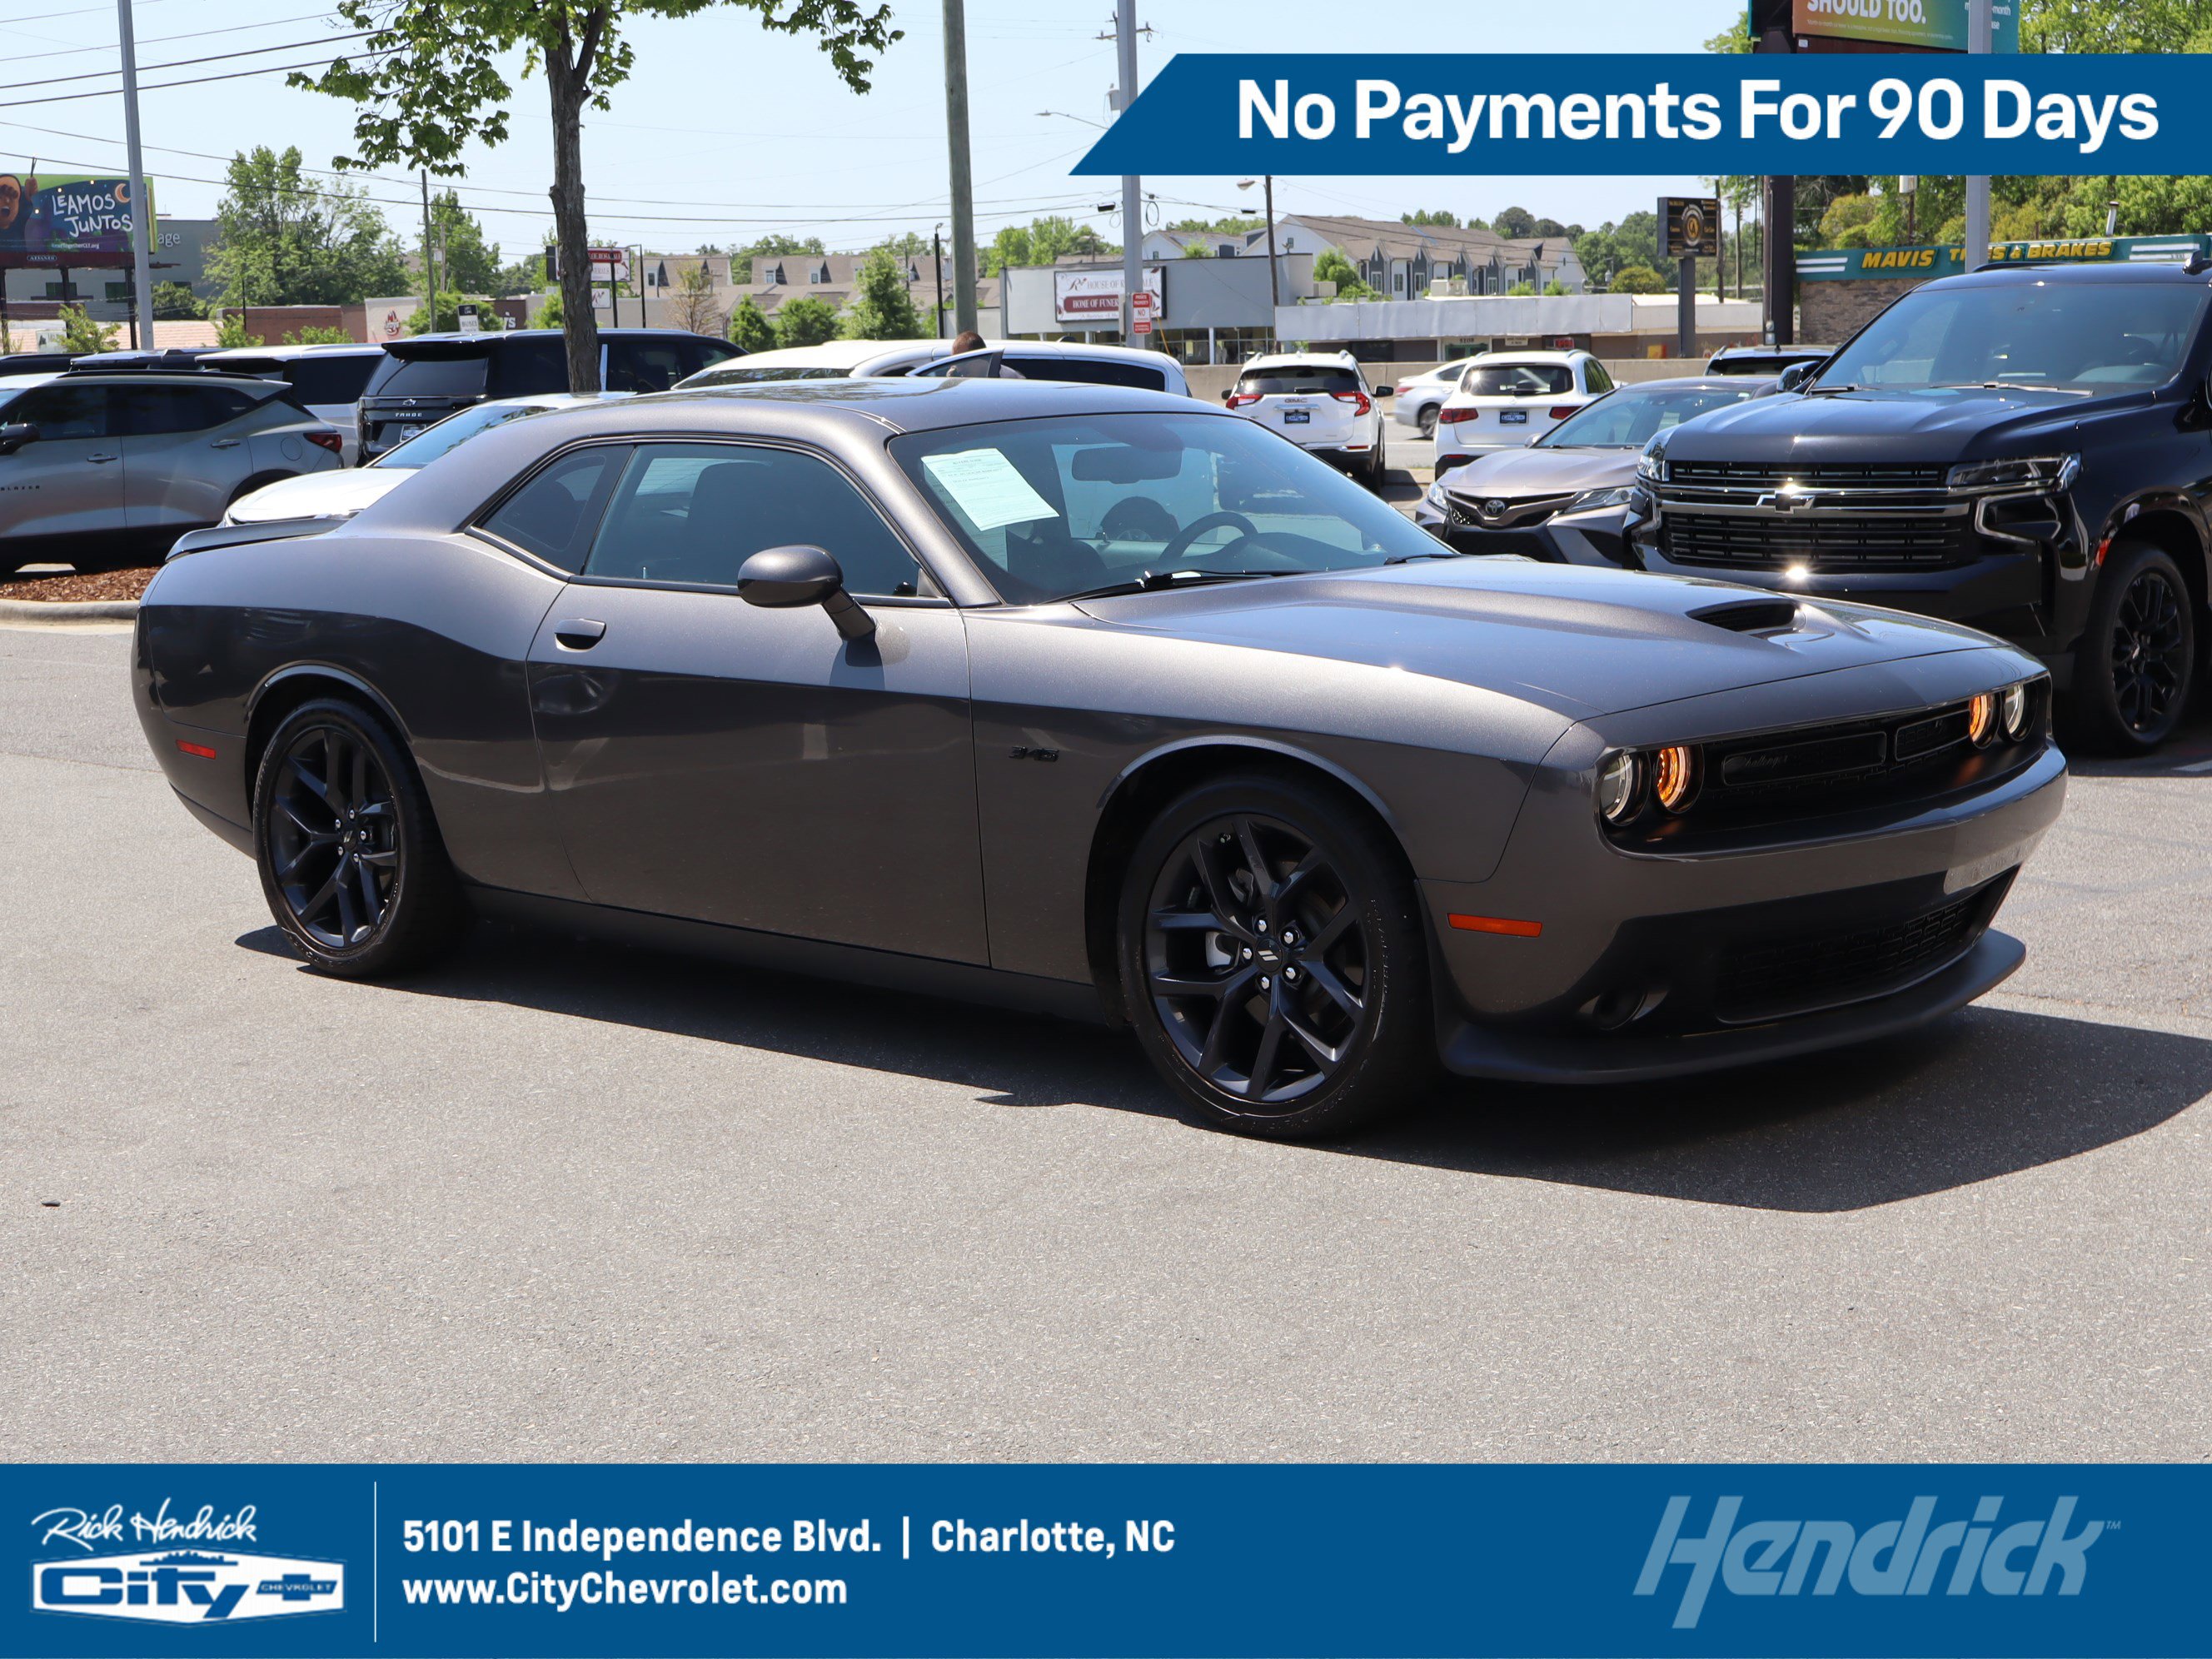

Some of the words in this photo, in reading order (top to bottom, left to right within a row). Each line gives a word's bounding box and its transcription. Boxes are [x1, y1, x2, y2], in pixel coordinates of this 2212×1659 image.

[1806, 0, 1881, 18] SHOULD
[1886, 0, 1926, 24] TOO.
[52, 192, 116, 216] LEAMOS
[63, 213, 133, 238] JUNTOS
[1861, 248, 1936, 269] MAVIS
[1949, 245, 2006, 262] TIS
[2026, 241, 2112, 259] BRAKES
[1073, 299, 1089, 309] HOME
[1089, 298, 1099, 307] OF
